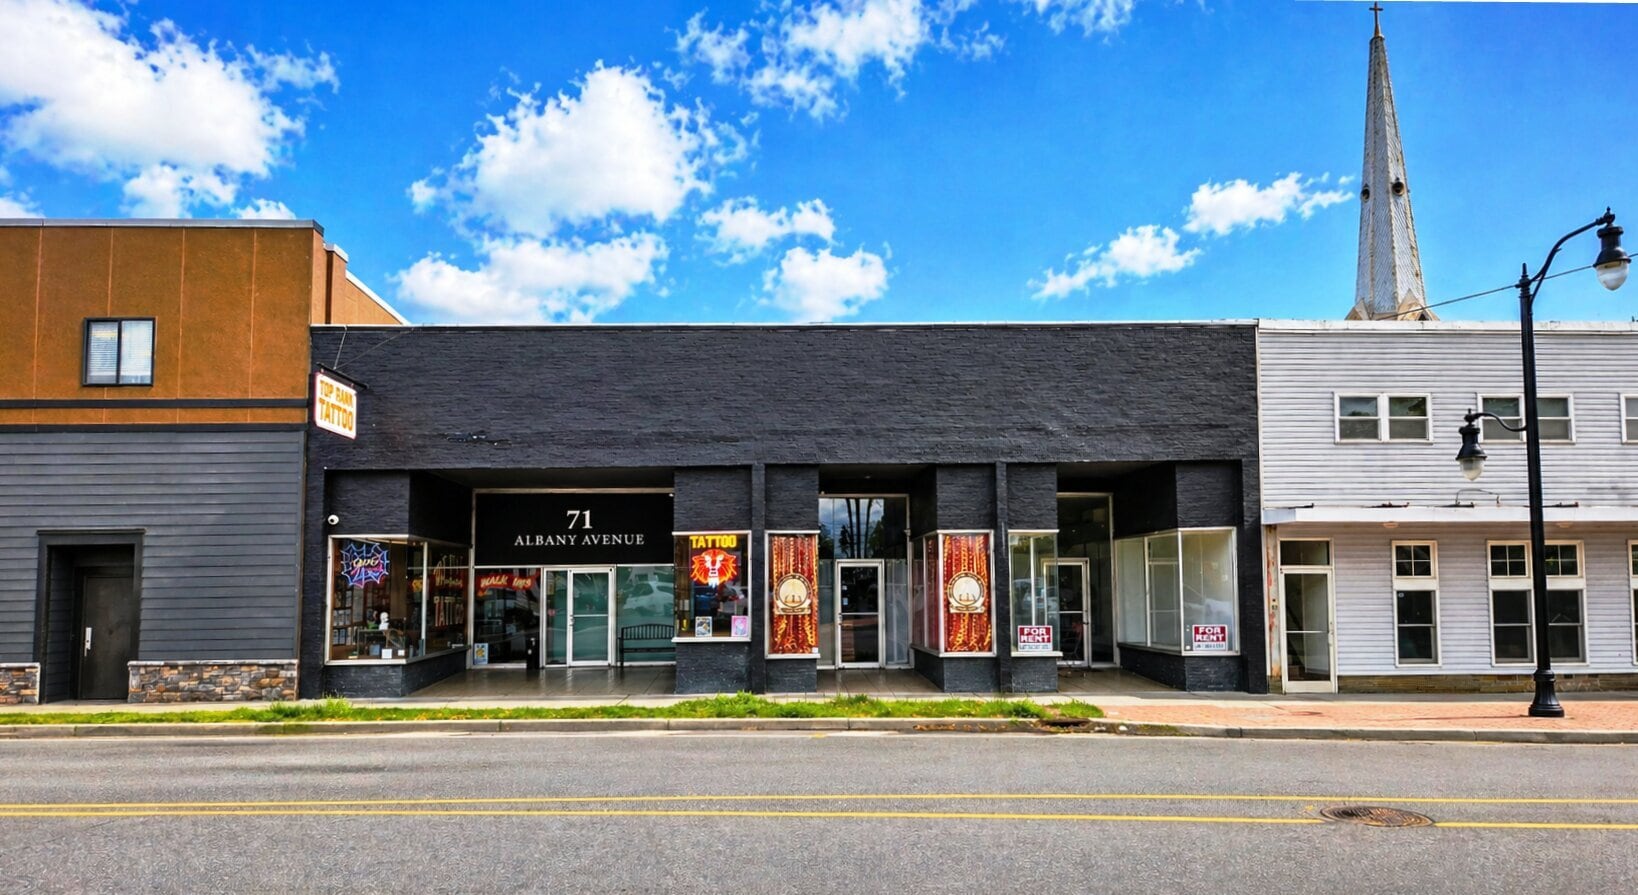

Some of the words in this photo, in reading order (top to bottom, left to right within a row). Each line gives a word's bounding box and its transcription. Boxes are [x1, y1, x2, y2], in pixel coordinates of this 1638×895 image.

[319, 379, 334, 398] TOP
[319, 397, 354, 431] TATTOO
[566, 509, 593, 530] 71
[514, 534, 578, 546] ALBANY
[581, 534, 645, 546] AVENUE
[689, 534, 737, 549] TATTOO
